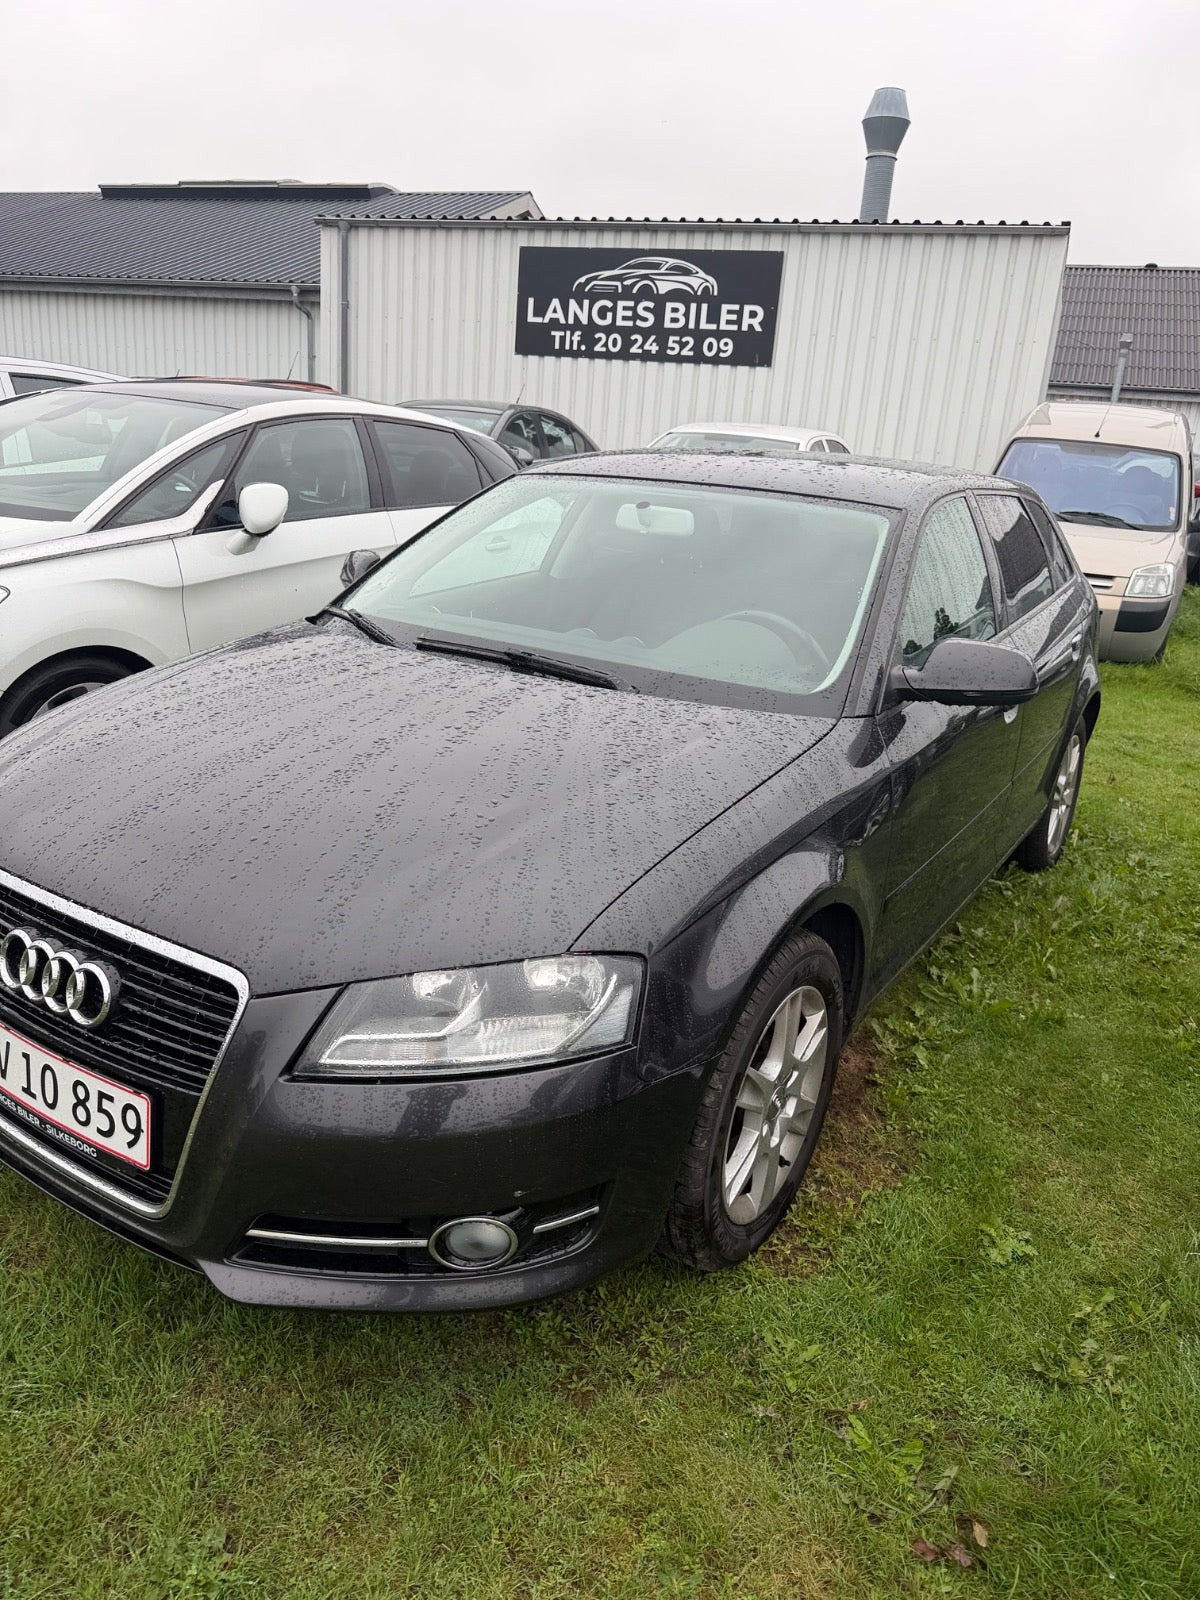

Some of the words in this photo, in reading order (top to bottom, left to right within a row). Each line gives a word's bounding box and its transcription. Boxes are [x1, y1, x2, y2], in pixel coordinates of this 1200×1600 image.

[526, 297, 656, 328] LANGES
[663, 301, 766, 332] BILER
[551, 330, 587, 351] Tlf.
[593, 332, 623, 353] 20
[629, 334, 660, 355] 24
[666, 336, 695, 356] 52
[702, 337, 734, 358] 09
[21, 1051, 59, 1111] 10
[71, 1079, 143, 1150] 859
[17, 1105, 40, 1127] BILER
[46, 1123, 98, 1158] SILKEBORG
